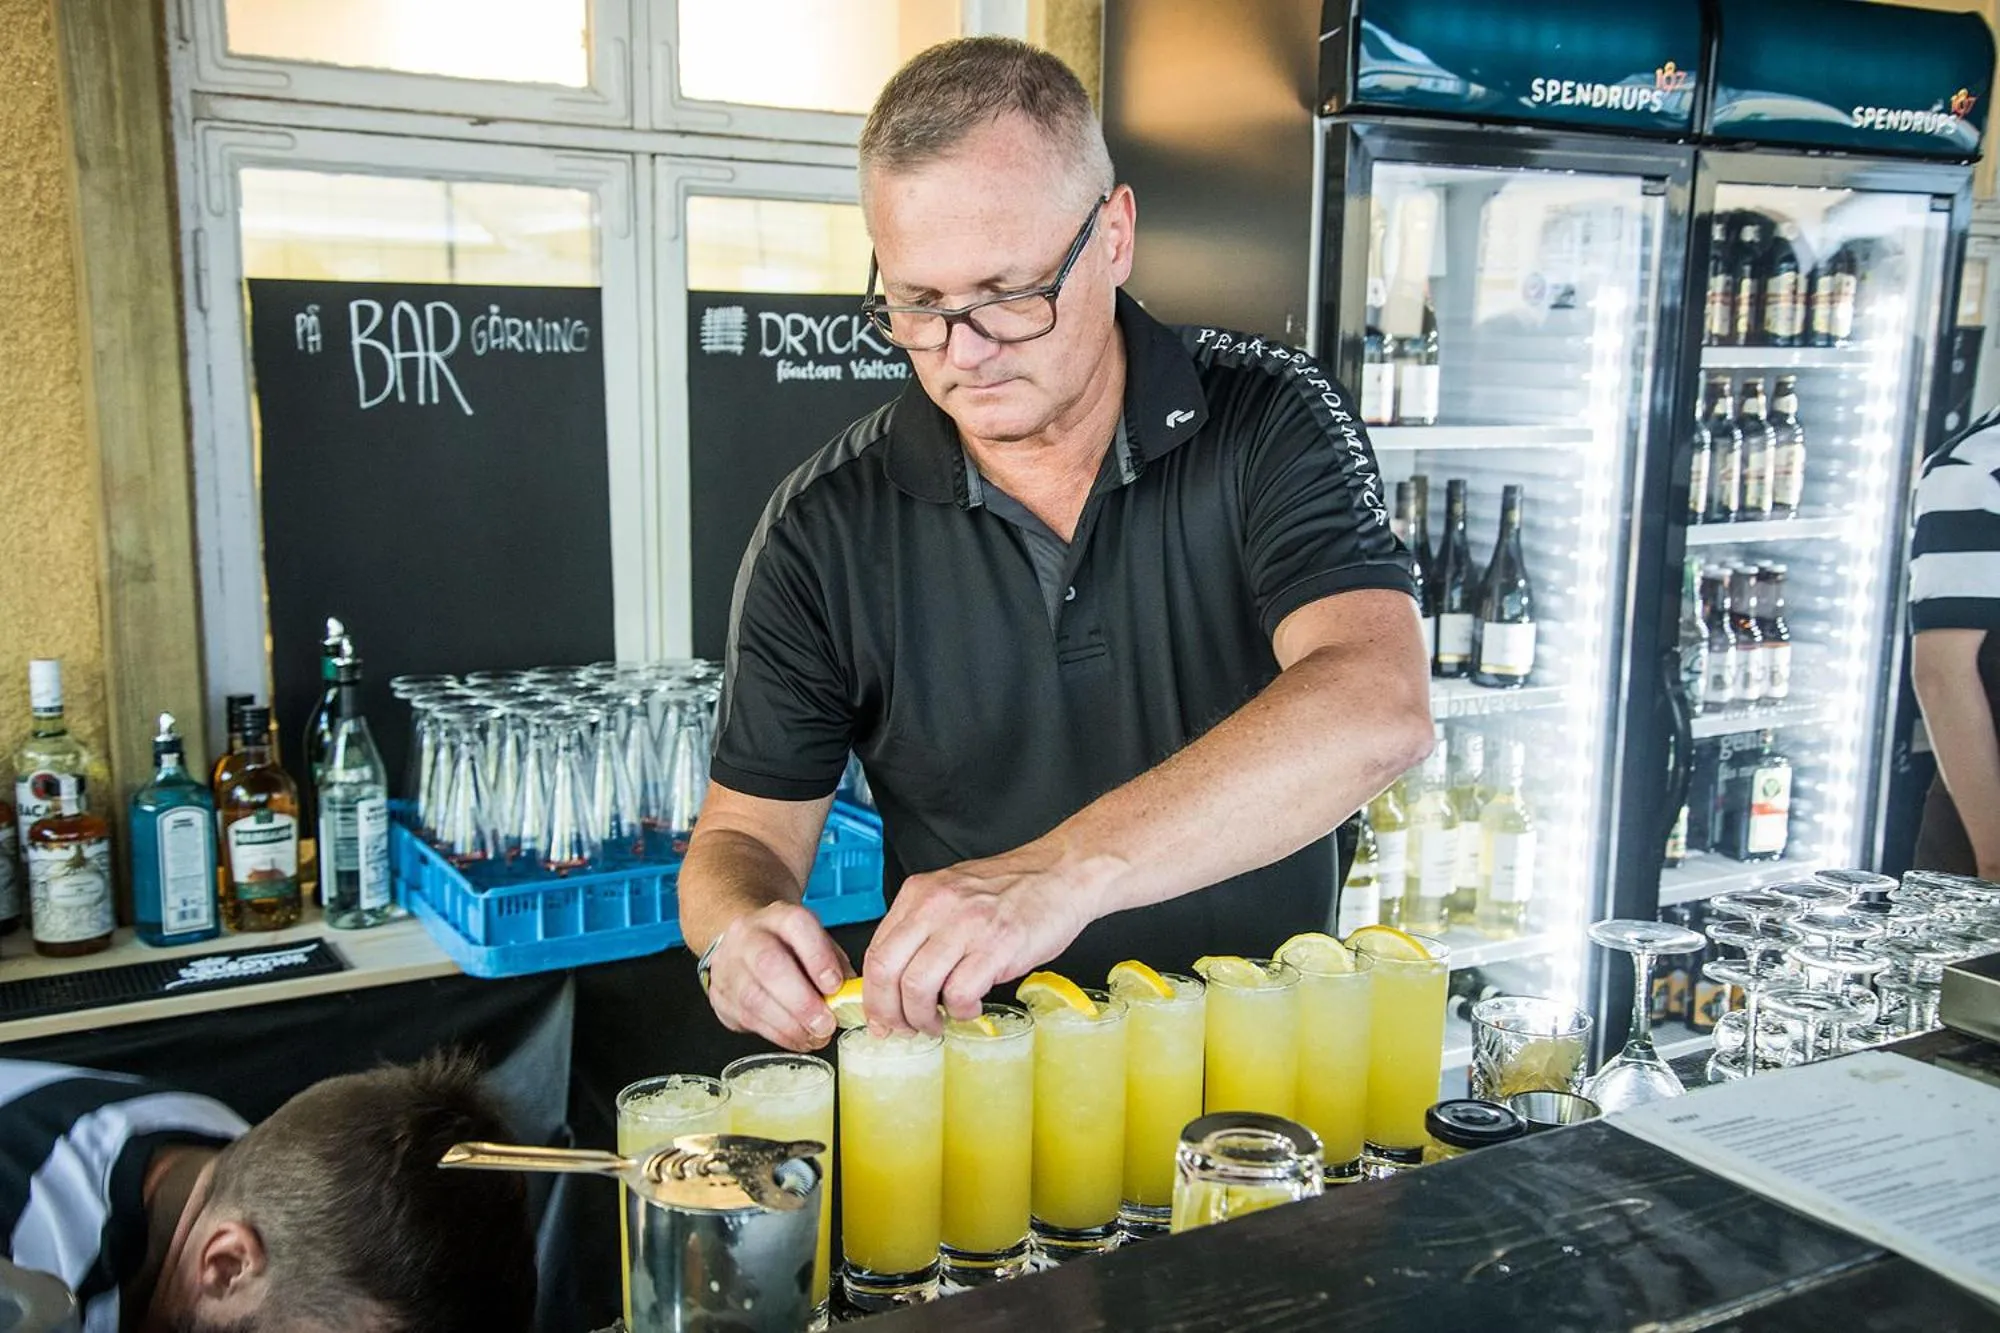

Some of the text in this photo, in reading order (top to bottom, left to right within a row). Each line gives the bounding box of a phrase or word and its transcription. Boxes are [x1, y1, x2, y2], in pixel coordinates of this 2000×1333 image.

[1531, 77, 1664, 113] SPENDRUPS
[1852, 106, 1958, 135] SPENDRUPS
[295, 304, 321, 353] PÅ
[349, 300, 473, 415] BAR
[1196, 328, 1269, 359] PEAK
